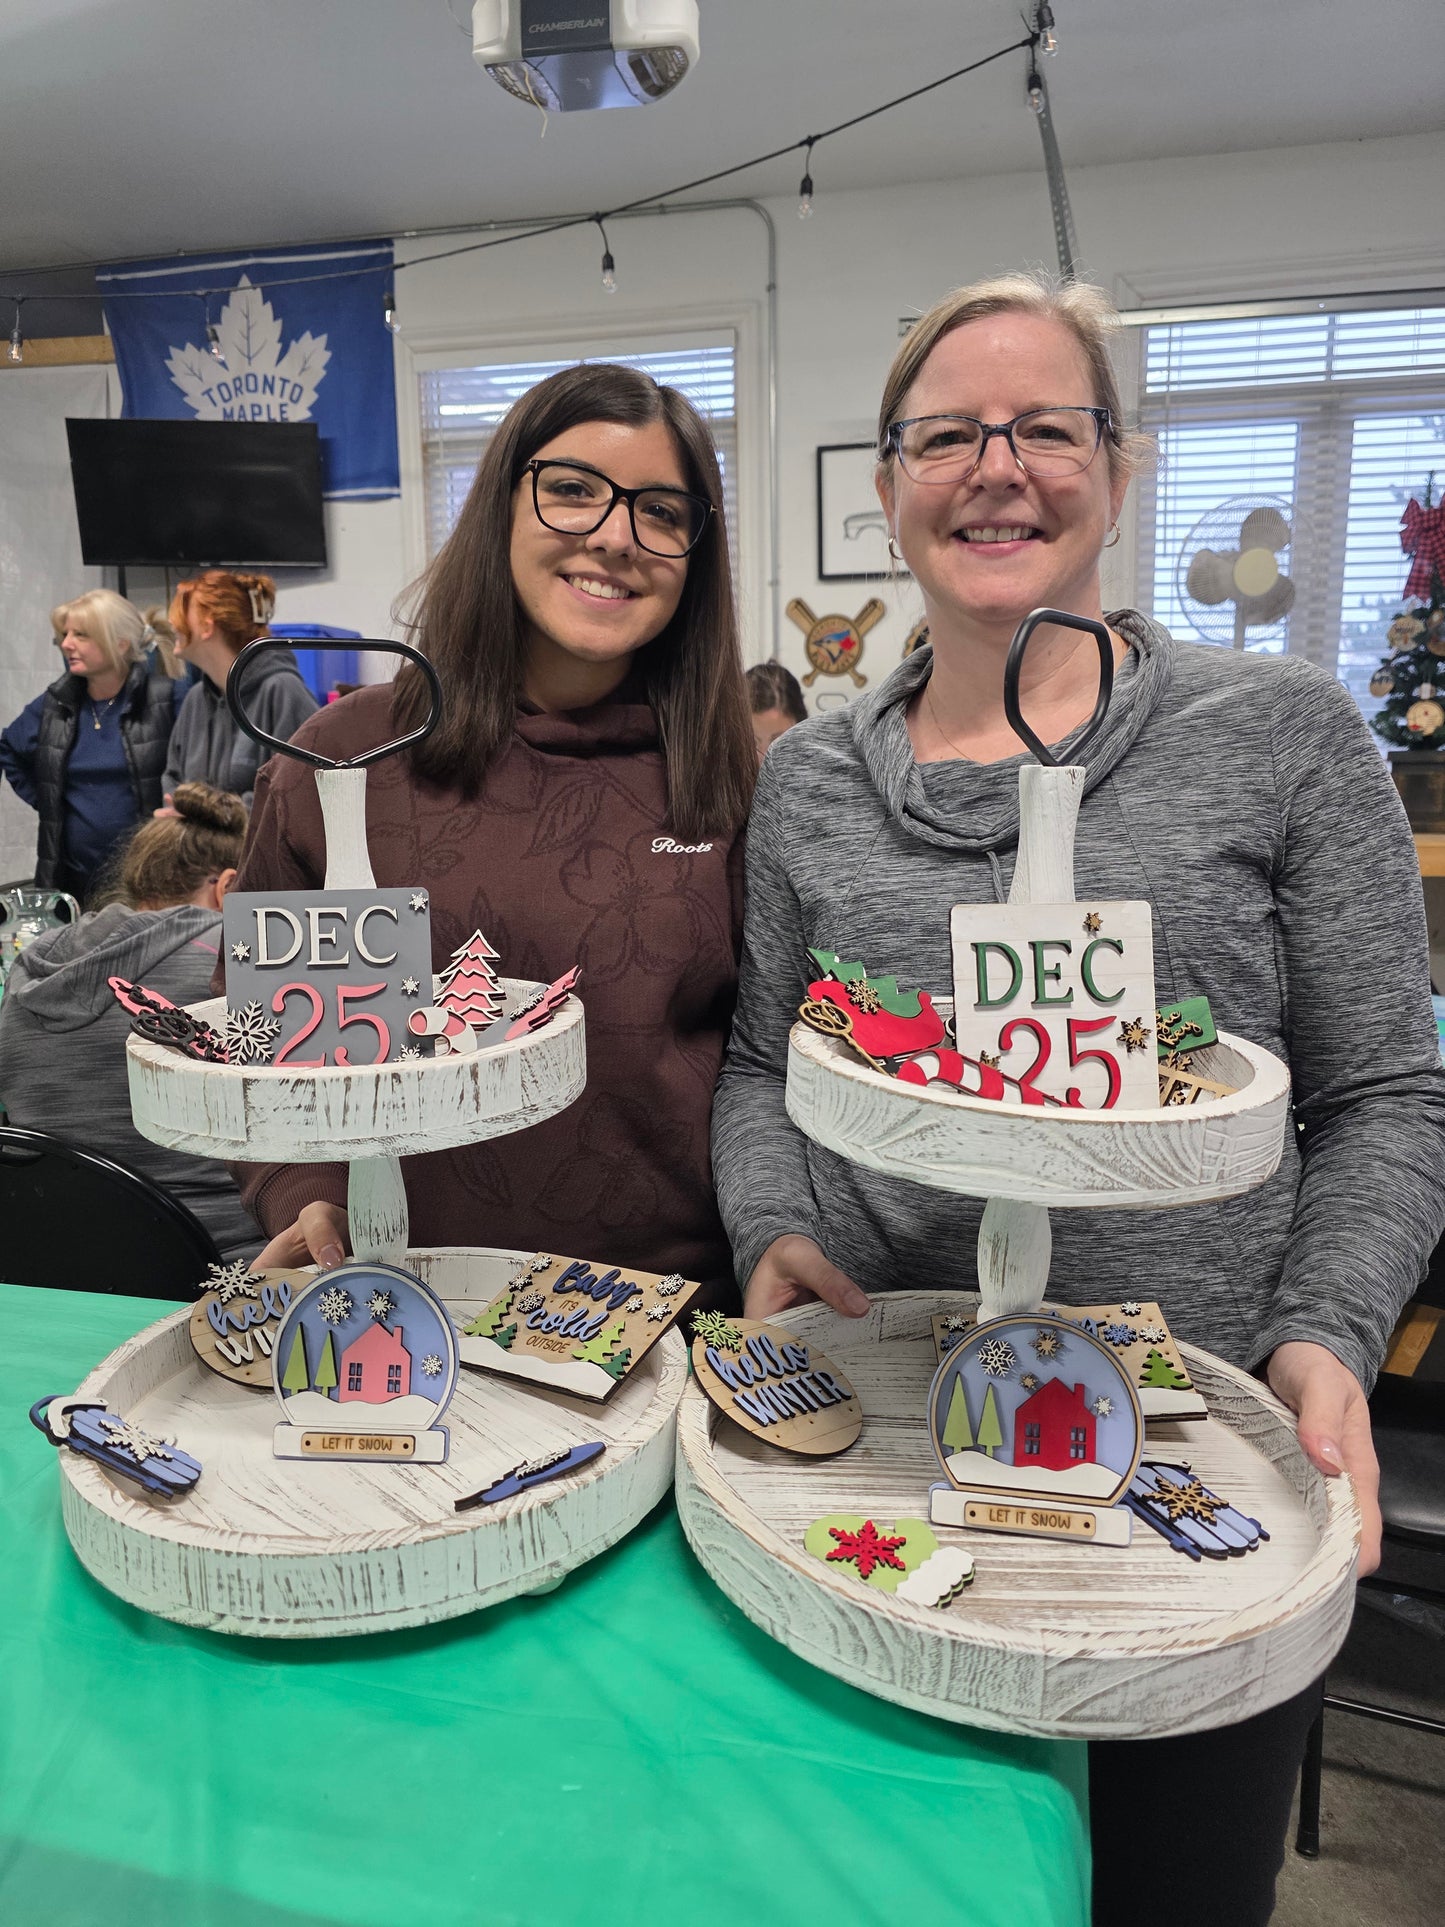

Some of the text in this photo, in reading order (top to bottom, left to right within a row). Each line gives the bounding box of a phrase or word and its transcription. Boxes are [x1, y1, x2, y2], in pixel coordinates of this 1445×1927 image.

[528, 18, 605, 34] CHAMBERLAIN
[201, 372, 305, 407] TORONTO
[222, 403, 289, 421] MAPLE
[650, 836, 713, 853] Roots
[252, 905, 399, 967] DEC
[970, 937, 1126, 1007] DEC
[271, 982, 388, 1067] 25
[998, 1015, 1122, 1109] 25
[552, 1261, 644, 1311] Baby
[207, 1280, 293, 1338] hell
[526, 1306, 610, 1342] cold
[526, 1335, 571, 1353] OUTSIDE
[704, 1333, 811, 1393] hello
[732, 1369, 853, 1427] WINTER
[322, 1437, 393, 1452] LET IT SNOW
[988, 1508, 1072, 1530] LET IT SNOW
